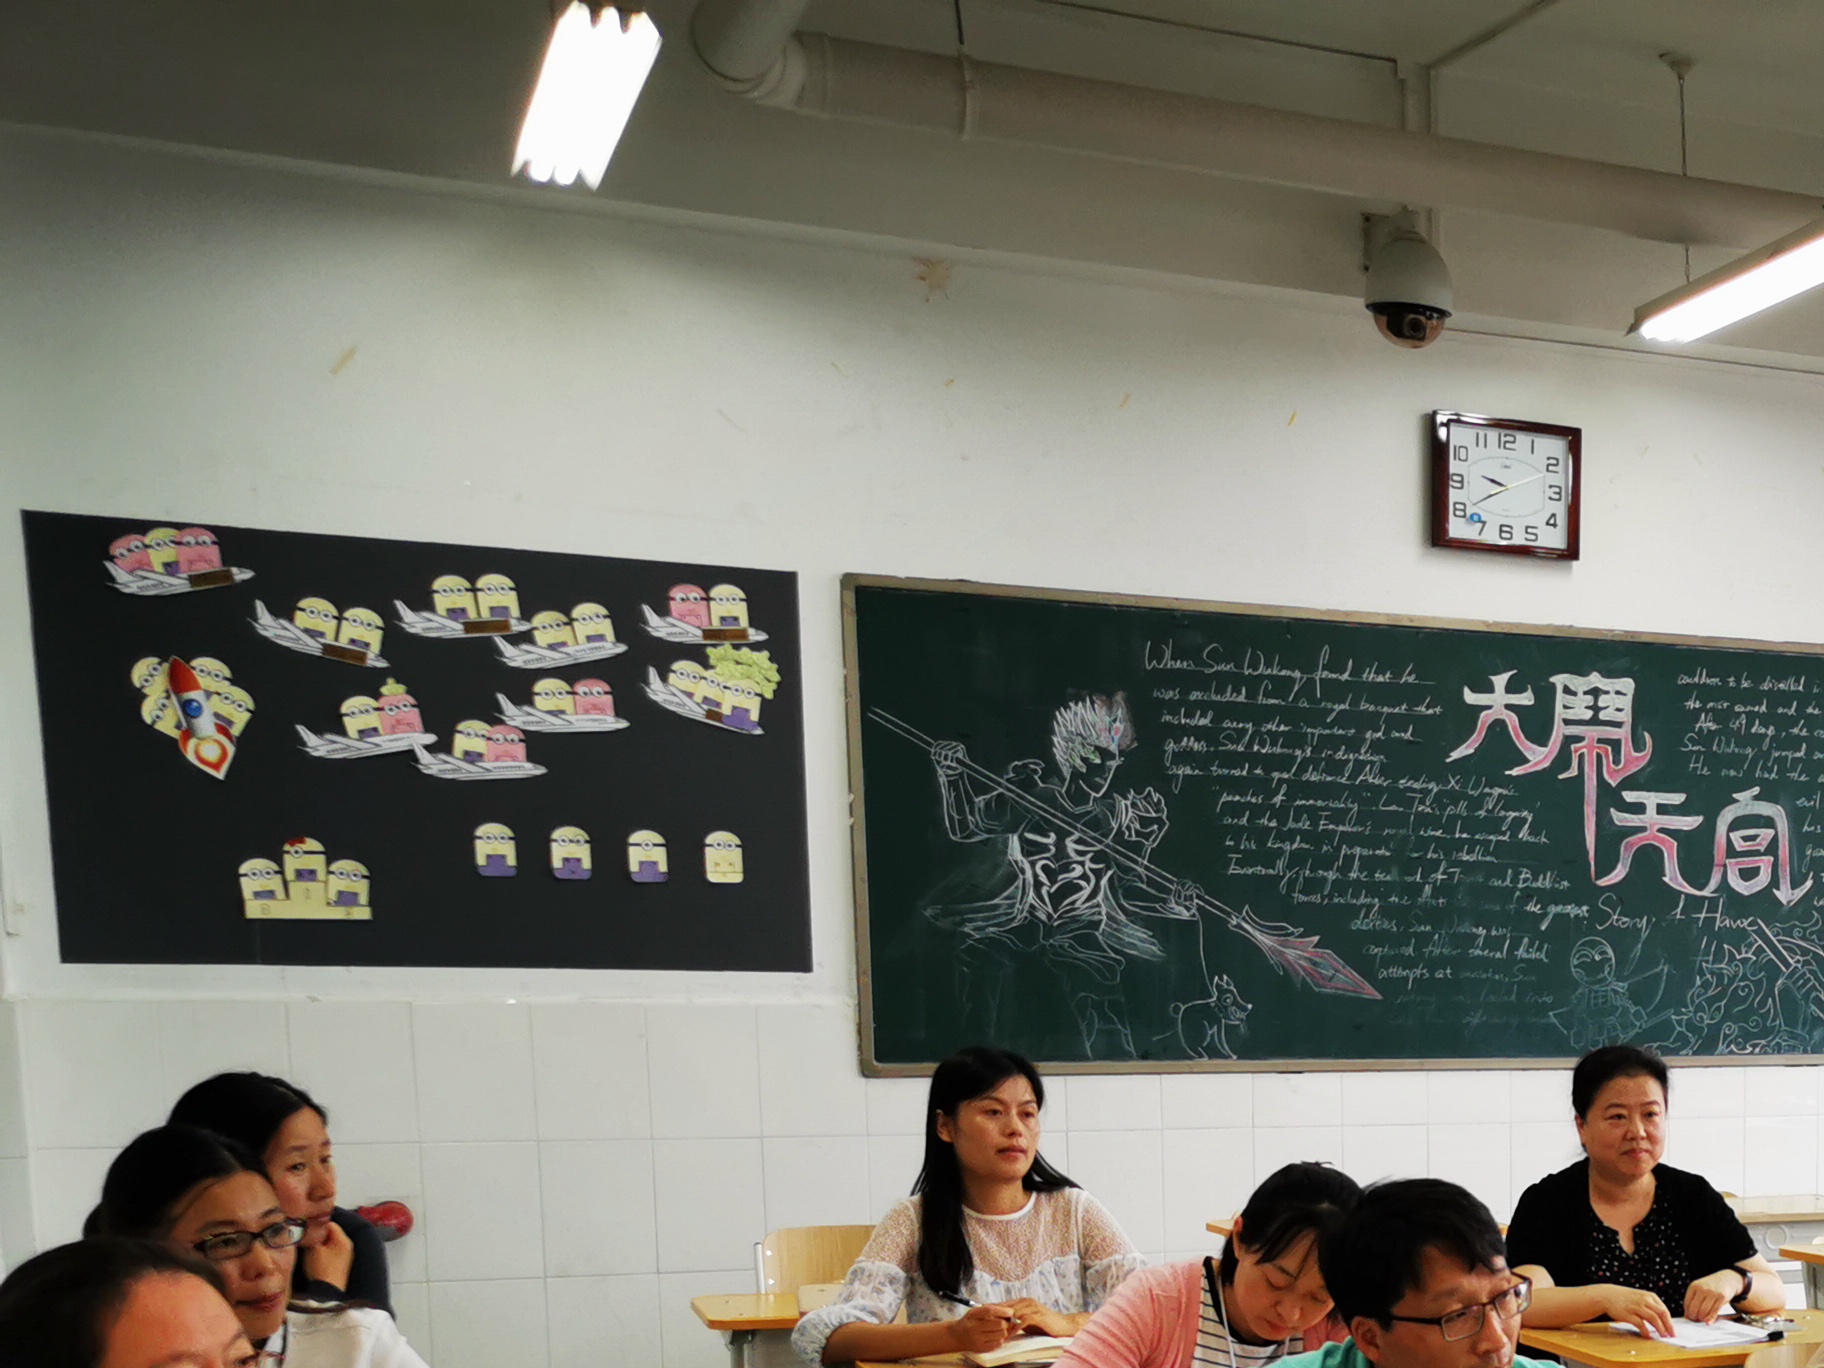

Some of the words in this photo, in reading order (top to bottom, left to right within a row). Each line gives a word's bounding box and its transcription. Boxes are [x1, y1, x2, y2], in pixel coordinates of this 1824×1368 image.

[1453, 445, 1469, 462] 10
[1475, 432, 1488, 449] 11
[1498, 432, 1517, 451] 12
[1530, 438, 1535, 455] 1
[1546, 456, 1560, 474] 2
[1450, 473, 1464, 490] 9
[1548, 485, 1562, 502] 3
[1453, 501, 1467, 519] 8
[1545, 513, 1558, 529] 4
[1475, 520, 1487, 536] 7
[1499, 524, 1514, 541] 6
[1524, 525, 1539, 542] 5
[1145, 638, 1196, 670] When
[1203, 643, 1236, 674] Sun
[1244, 646, 1306, 702] Wukong
[1362, 661, 1393, 683] that
[1727, 675, 1737, 688] to
[1740, 671, 1754, 689] be
[1153, 687, 1180, 700] was
[1257, 679, 1286, 705] from
[1299, 697, 1310, 709] a
[1413, 695, 1443, 716] that
[1684, 690, 1703, 711] the
[1776, 700, 1797, 716] and
[1161, 707, 1213, 727] included
[1261, 715, 1292, 732] other
[1365, 723, 1386, 752] god
[1391, 723, 1416, 741] and
[1729, 713, 1746, 736] 49
[1789, 719, 1809, 736] the
[1165, 762, 1204, 792] again
[1446, 773, 1463, 790] Xi
[1689, 753, 1711, 776] He
[1755, 760, 1778, 780] had
[1786, 763, 1809, 782] the
[1269, 784, 1287, 808] of
[1796, 791, 1821, 810] evil
[1223, 810, 1249, 826] and
[1254, 810, 1278, 828] the
[1347, 862, 1369, 881] the
[1488, 868, 1513, 887] and
[1523, 898, 1543, 914] the
[1595, 892, 1656, 976] Story
[1378, 963, 1430, 990] attempts
[1434, 966, 1453, 979] at
